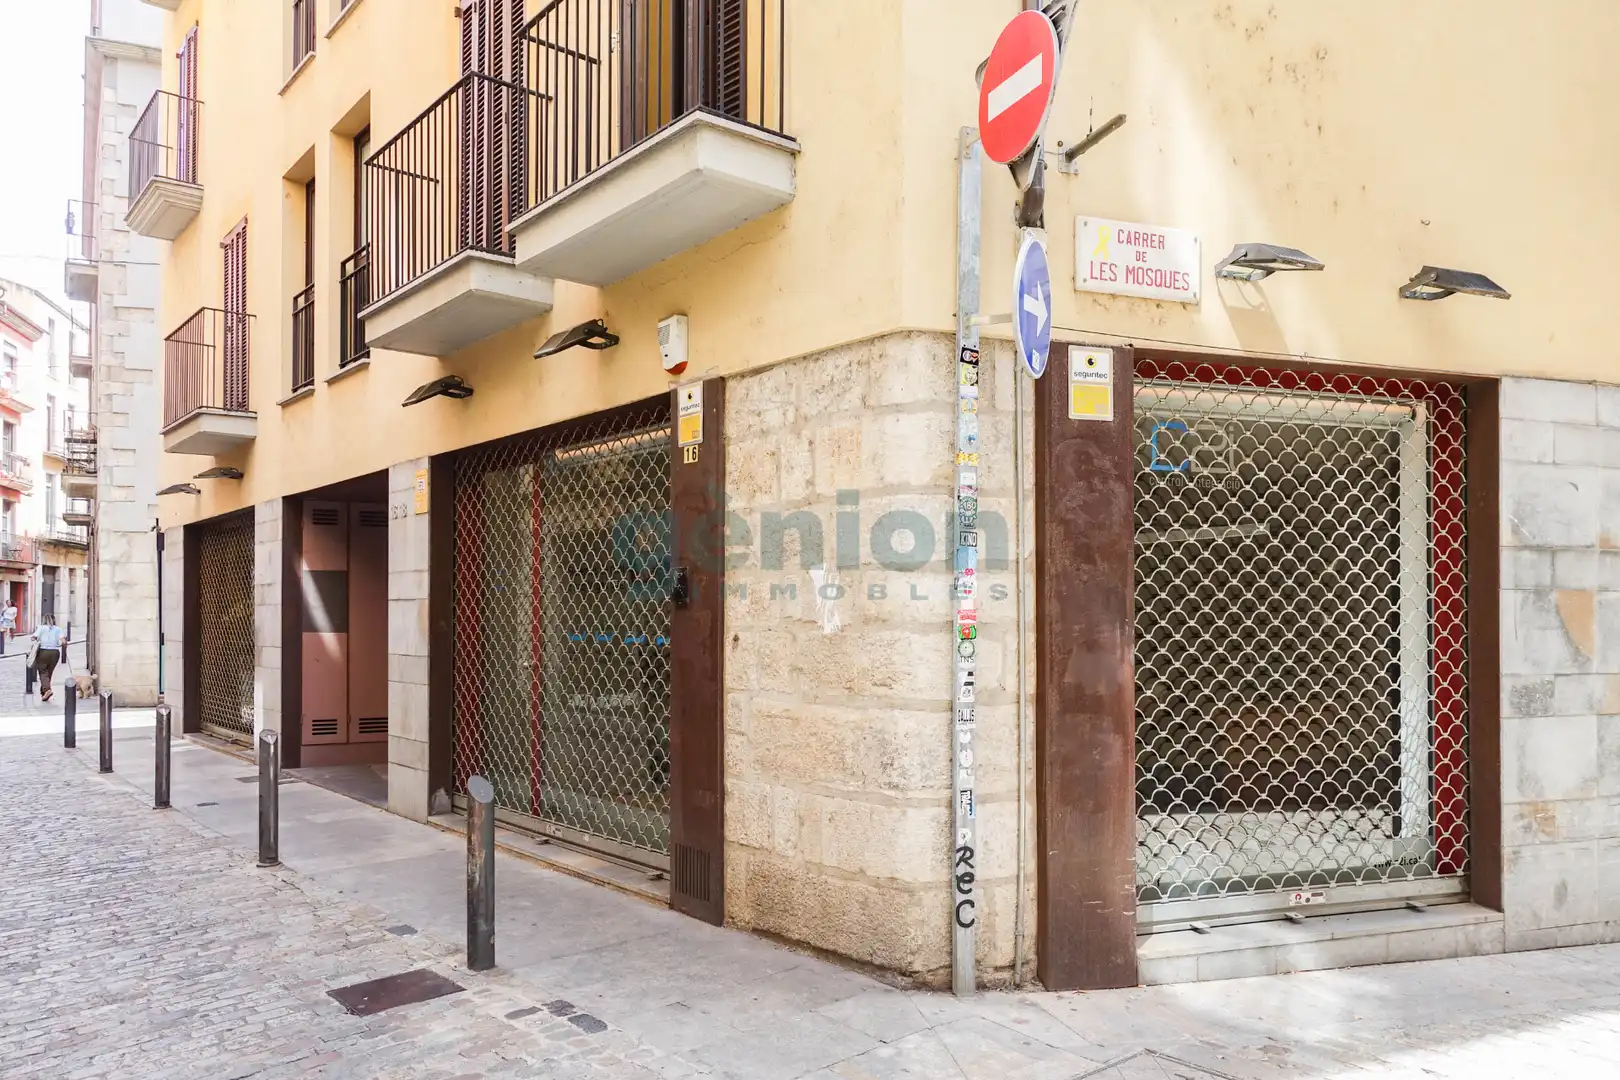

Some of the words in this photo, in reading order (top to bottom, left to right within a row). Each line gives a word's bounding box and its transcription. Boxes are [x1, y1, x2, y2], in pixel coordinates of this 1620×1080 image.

[1117, 228, 1165, 250] CARRER
[1135, 250, 1148, 262] DE
[1090, 260, 1118, 282] LES
[1125, 264, 1190, 291] MOSQUES
[1073, 370, 1108, 379] seguritec
[685, 446, 697, 462] 16
